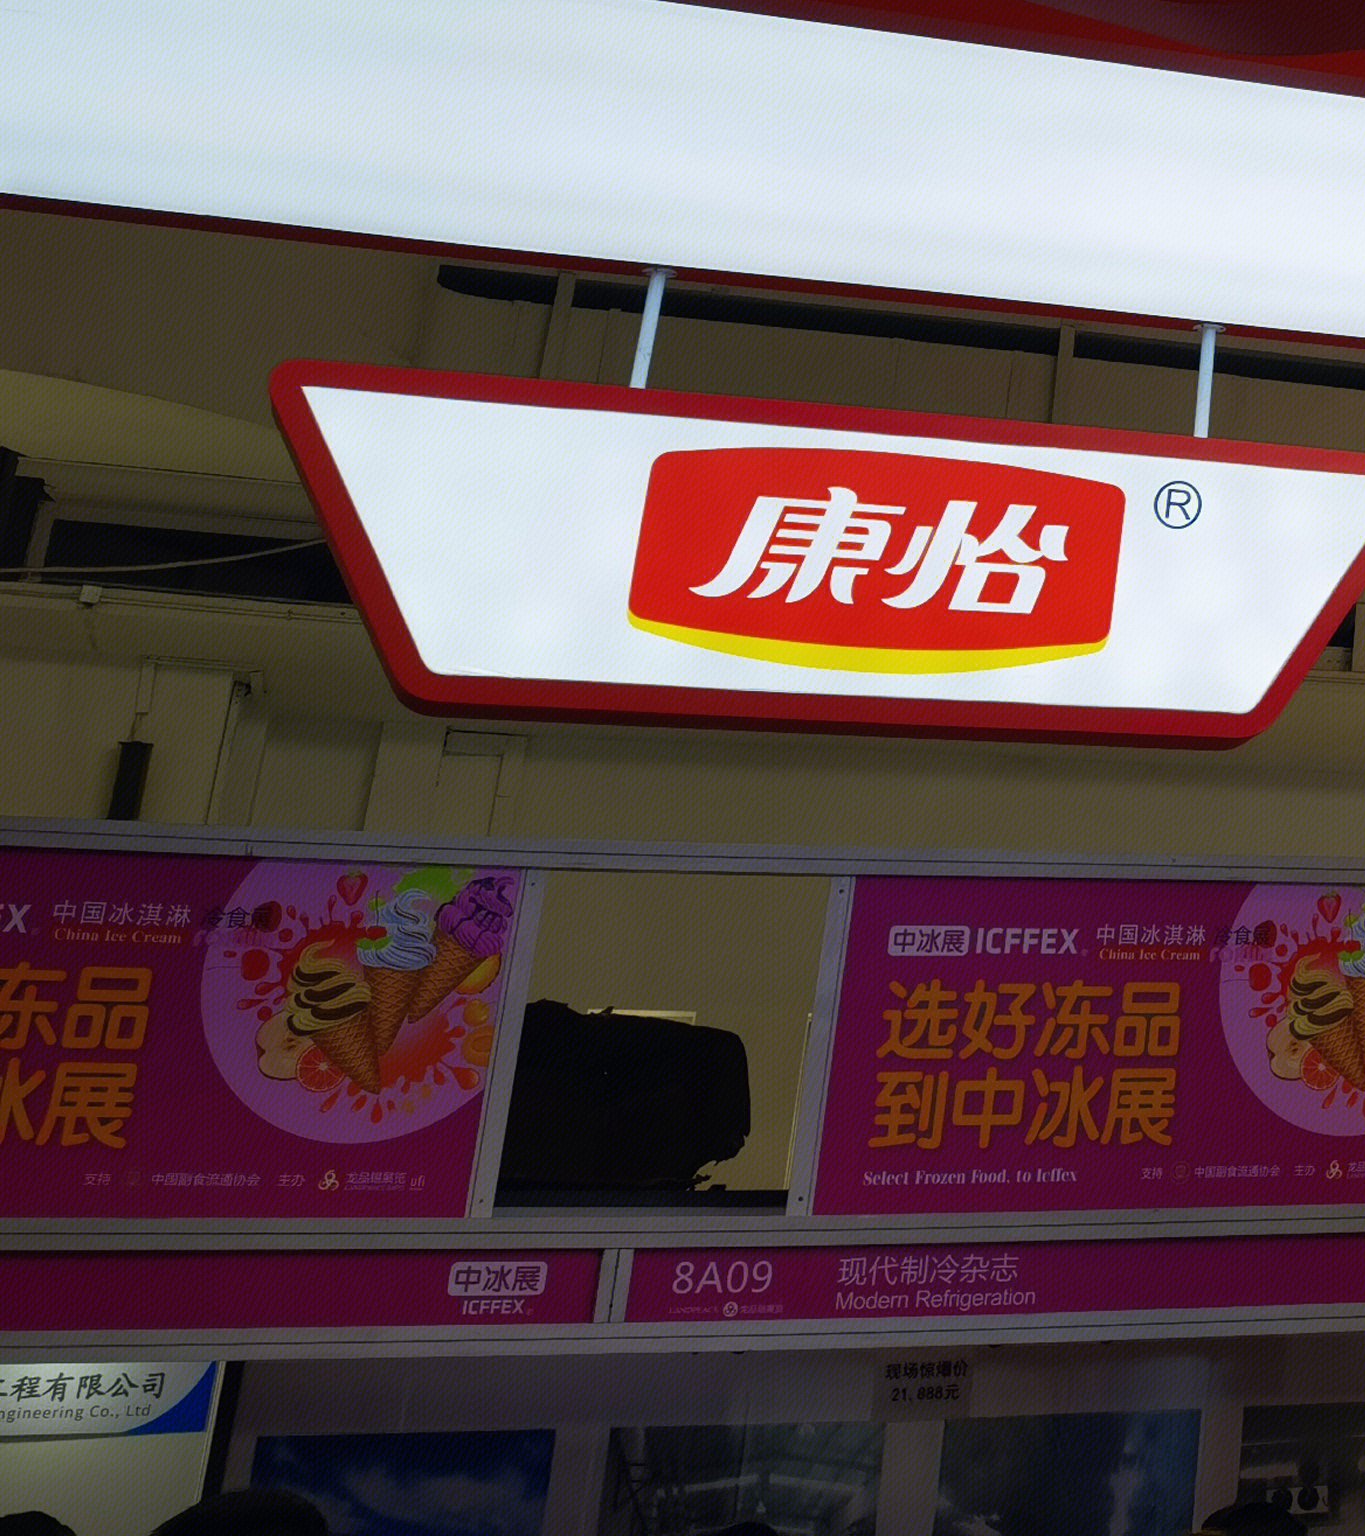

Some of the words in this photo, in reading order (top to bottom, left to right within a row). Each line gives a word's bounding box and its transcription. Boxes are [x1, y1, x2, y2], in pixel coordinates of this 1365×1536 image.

[689, 486, 1070, 613] 康怡
[52, 899, 192, 927] 中国冰淇淋
[53, 927, 99, 942] China
[104, 928, 127, 942] Ice
[131, 929, 182, 944] Cream
[892, 929, 966, 953] 中冰展
[976, 927, 1080, 955] ICFFEX
[1096, 923, 1207, 946] 中国冰淇淋
[1099, 948, 1134, 961] China
[1138, 948, 1157, 961] Ice
[1160, 948, 1201, 962] Cream
[875, 979, 1181, 1061] 选好冻品
[868, 1066, 1177, 1150] 到中冰展
[862, 1169, 909, 1185] Select
[914, 1169, 967, 1185] Frozen
[1015, 1169, 1033, 1184] to
[453, 1265, 541, 1293] 中冰展
[672, 1260, 772, 1294] 8A09
[837, 1252, 1019, 1287] 现代制冷杂志
[461, 1299, 525, 1315] ICFFEX
[835, 1290, 909, 1311] Modern
[915, 1287, 1037, 1311] Refrigeration
[90, 1405, 119, 1420] Co.,
[126, 1404, 151, 1418] Ltd
